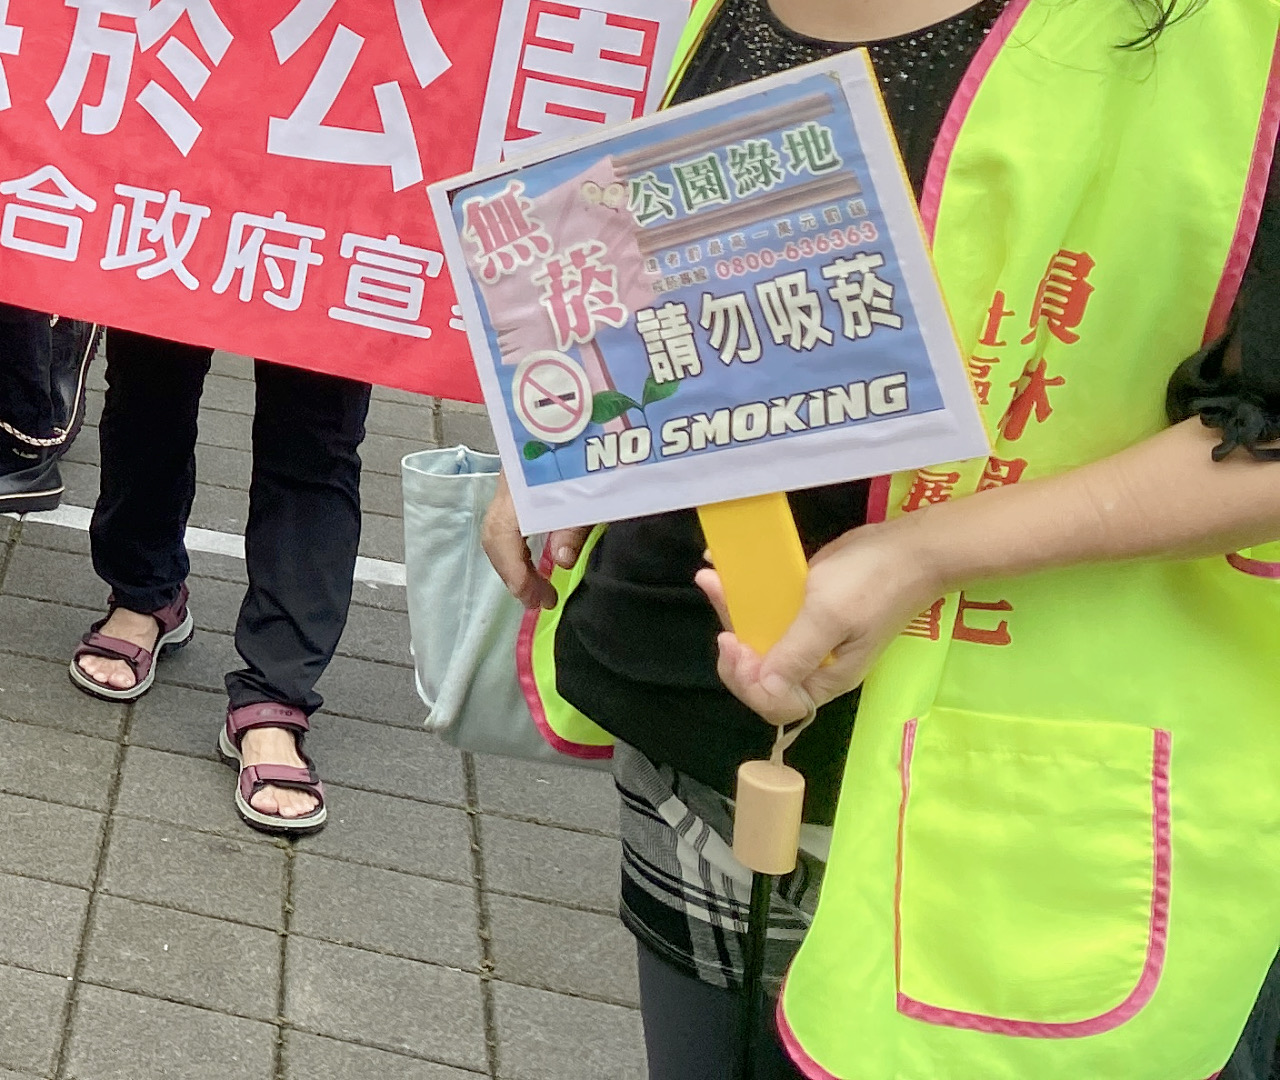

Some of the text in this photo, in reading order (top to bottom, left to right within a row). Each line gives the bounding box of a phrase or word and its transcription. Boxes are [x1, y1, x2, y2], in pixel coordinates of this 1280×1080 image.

[630, 122, 843, 226] 公園綠地
[464, 180, 628, 351] 無菸
[716, 221, 878, 279] 0800-636363
[636, 253, 904, 384] 請勿吸菸
[585, 371, 909, 471] NO SMOKING
